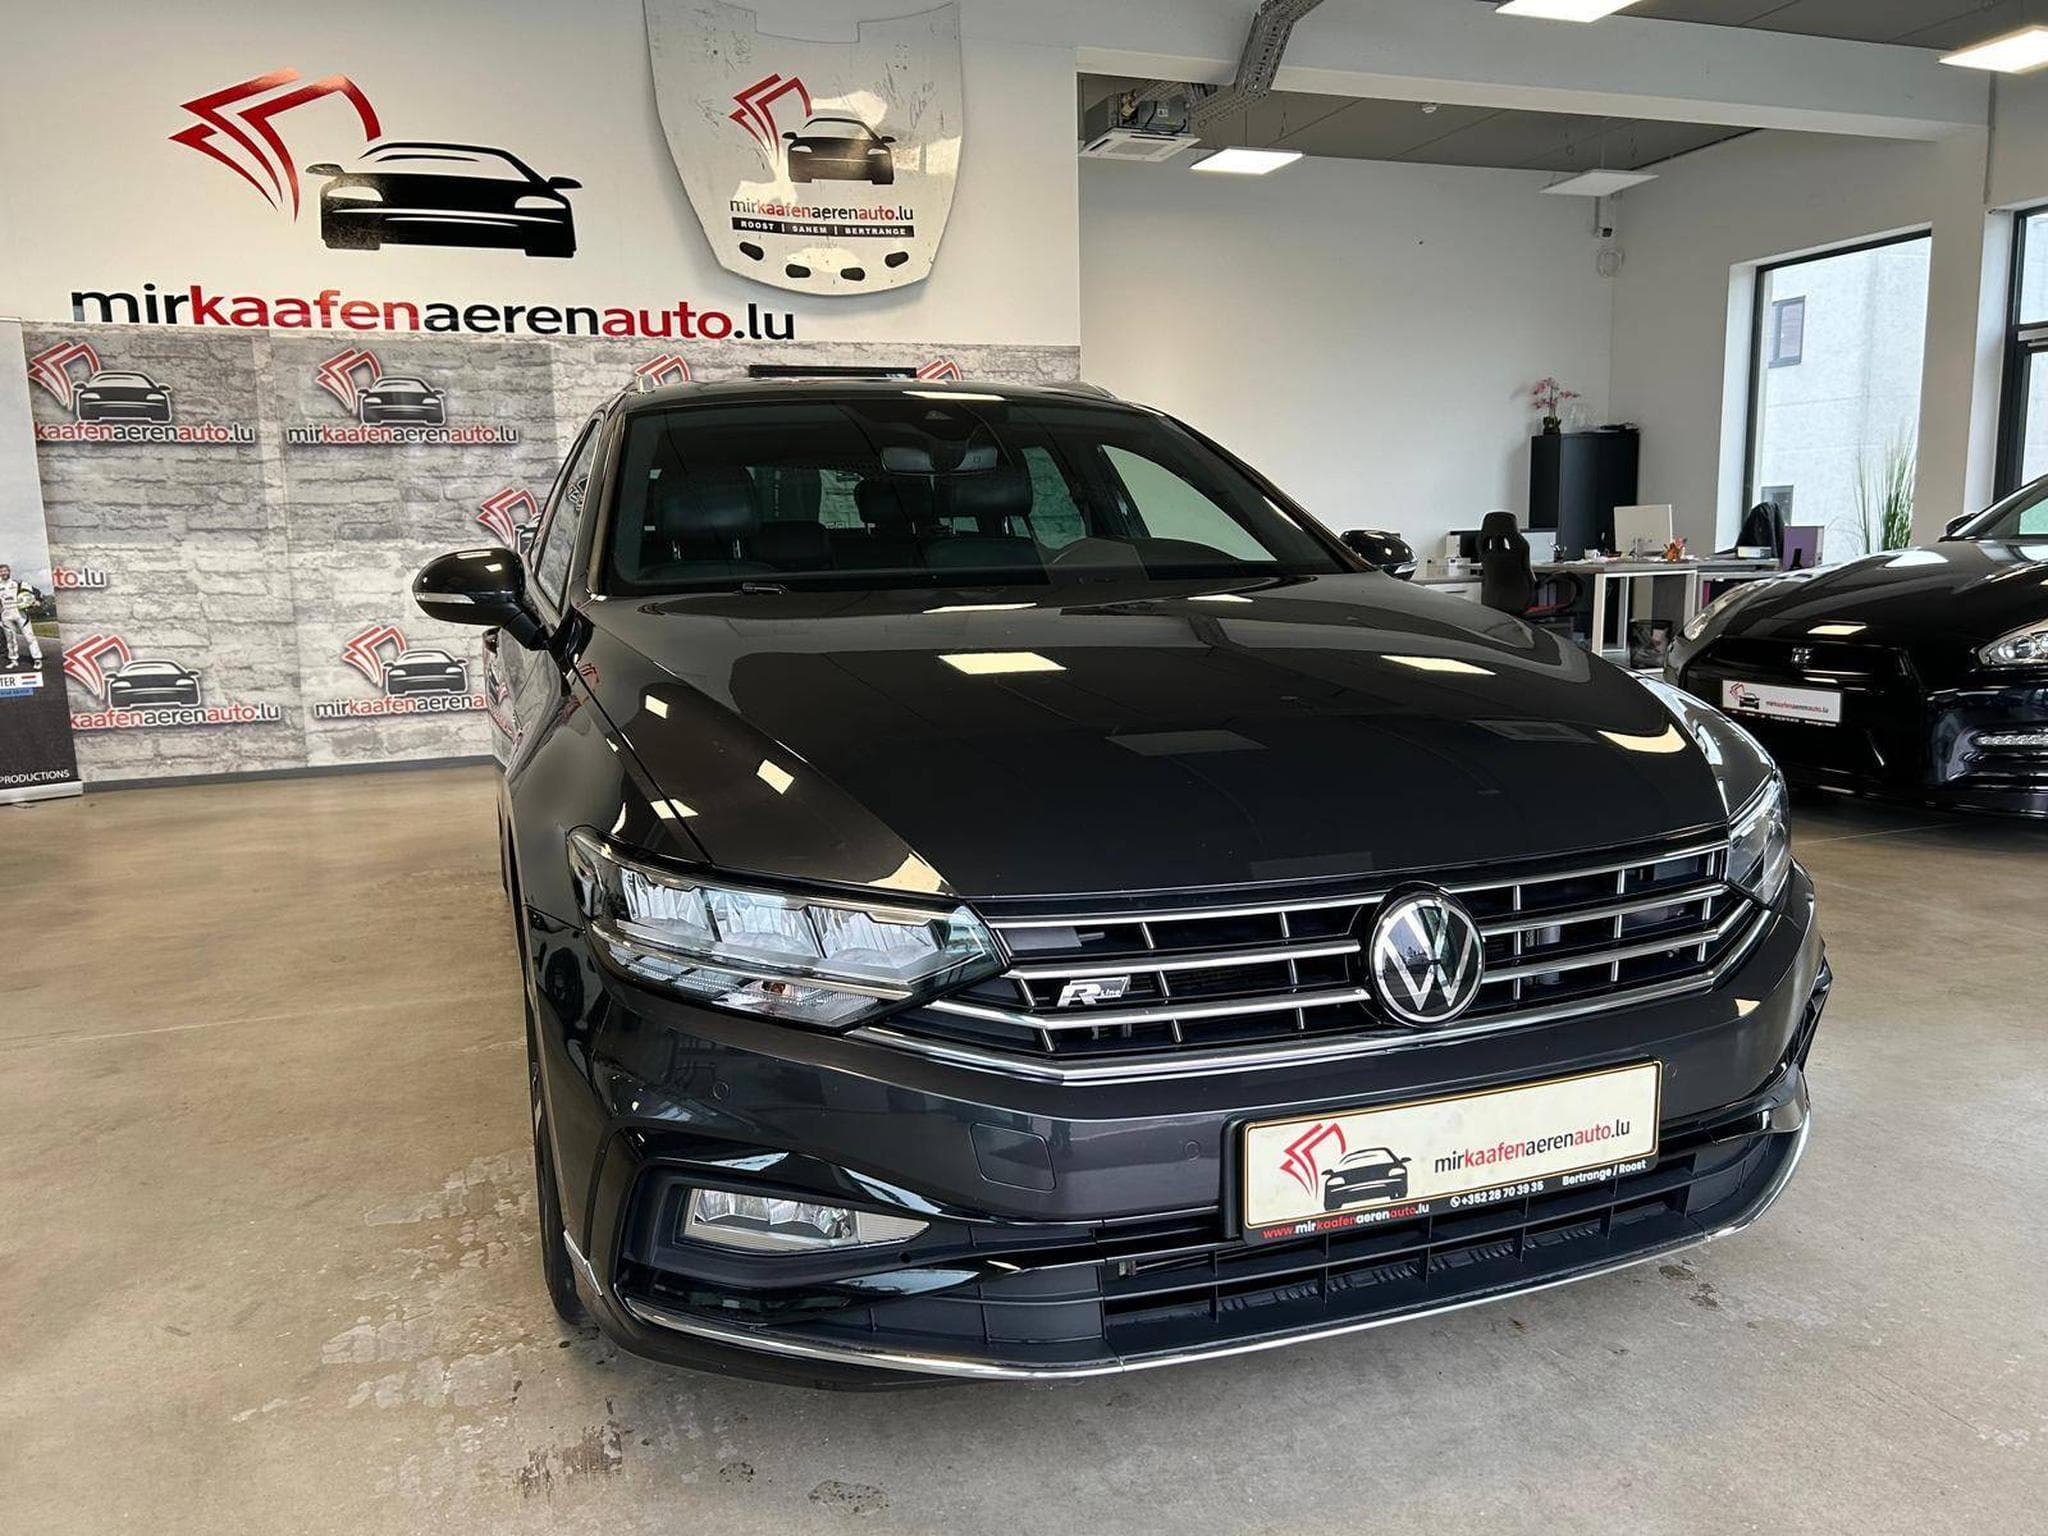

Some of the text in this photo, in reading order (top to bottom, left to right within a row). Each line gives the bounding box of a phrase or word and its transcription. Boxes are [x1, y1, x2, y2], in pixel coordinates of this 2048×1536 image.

[730, 198, 914, 220] mirkaafenaerenauto.lu
[740, 221, 907, 236] ROOST SANEM BERTRANGE
[71, 283, 794, 340] mirkaafenaerenauto.lu
[34, 421, 253, 442] kaafenaerenauto.lu
[288, 423, 518, 444] mirkaafenaerenauto.lu
[52, 567, 104, 586] to.lu
[0, 676, 16, 687] TER
[70, 703, 280, 728] kaafenaerenauto.lu
[315, 694, 486, 716] mirkaafenaerena
[1435, 1119, 1630, 1173] mirkaafenaerenauto.lu
[1562, 1168, 1612, 1186] Bertrange
[1619, 1160, 1647, 1174] Roost
[1461, 1181, 1544, 1206] +352 28 70 39 35
[1262, 1203, 1429, 1239] www.mirkaafenaerenauto.lu
